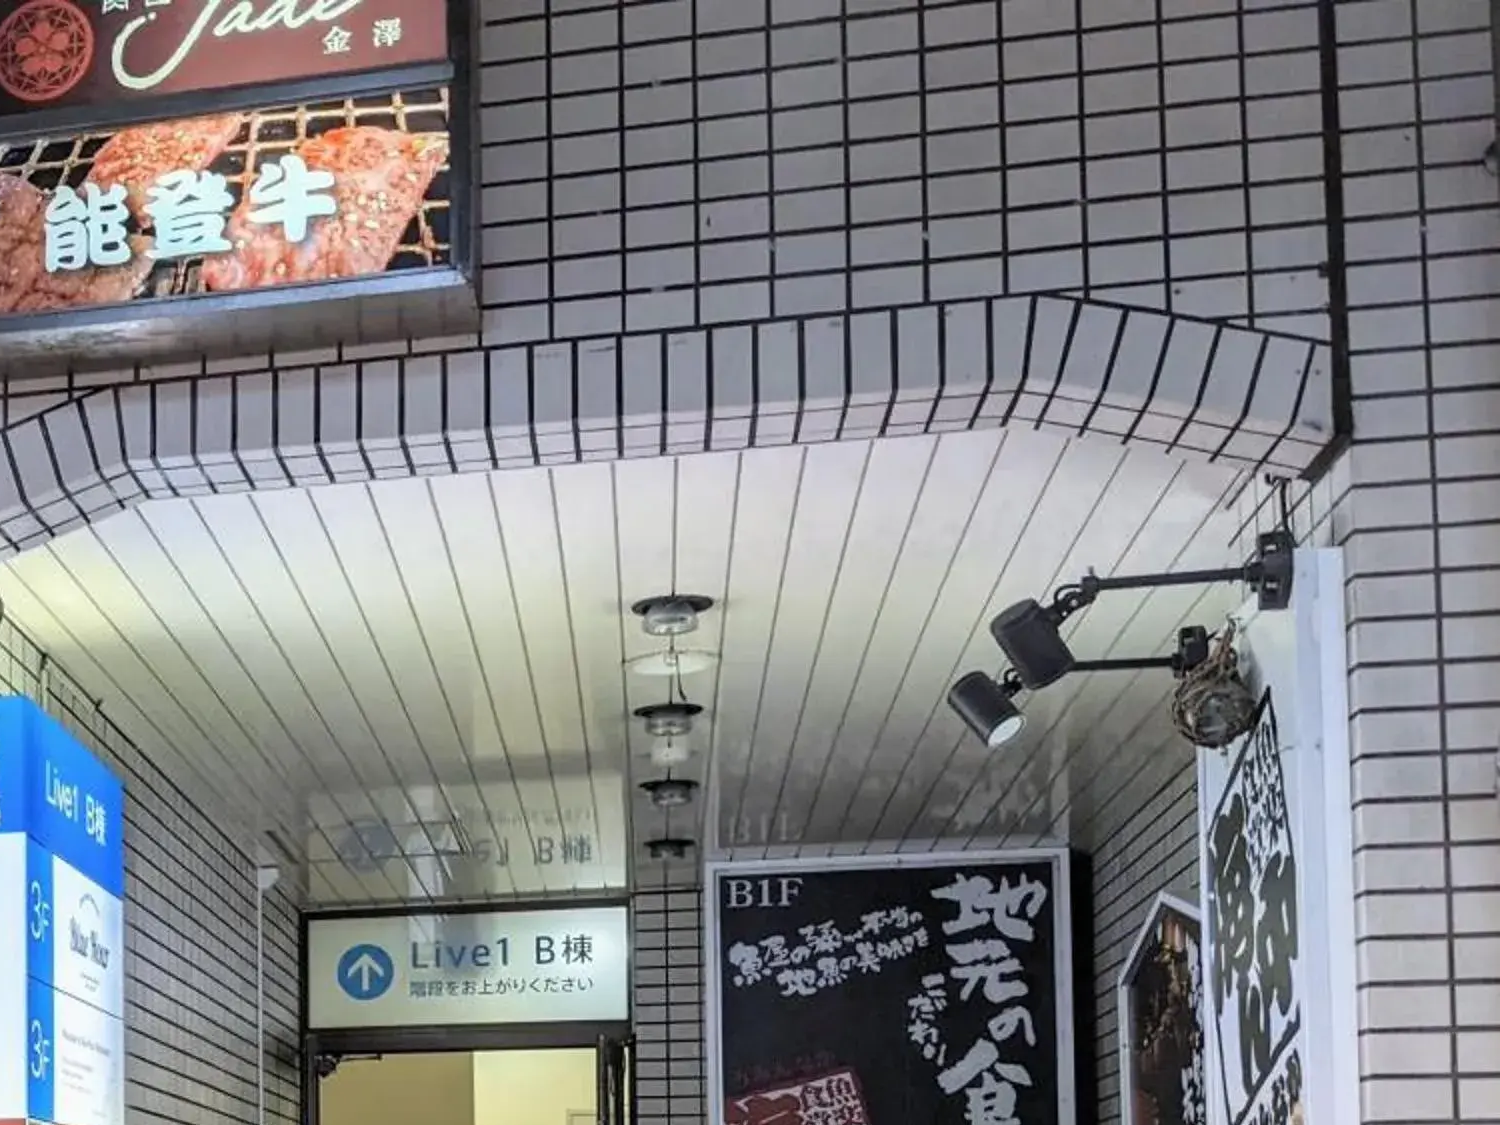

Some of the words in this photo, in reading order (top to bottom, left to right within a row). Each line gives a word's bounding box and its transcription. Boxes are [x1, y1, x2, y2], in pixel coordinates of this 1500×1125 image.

[43, 155, 336, 272] 能登牛
[46, 759, 79, 822] Live1
[727, 876, 804, 908] B1F
[411, 937, 509, 968] Live1
[535, 932, 594, 966] B棟
[409, 976, 594, 998] 階段をお上がりください
[907, 973, 948, 1065] こだわり
